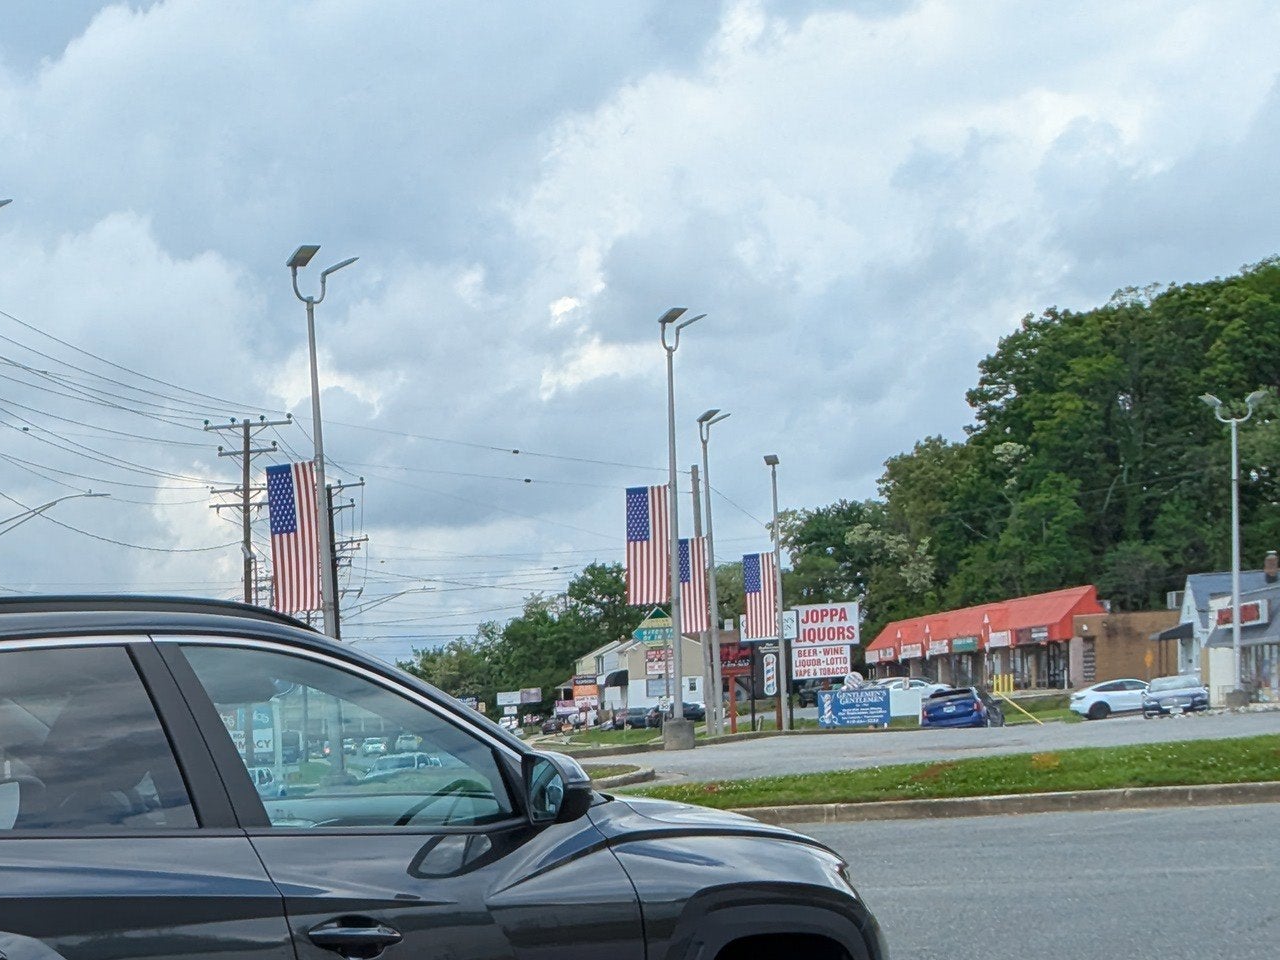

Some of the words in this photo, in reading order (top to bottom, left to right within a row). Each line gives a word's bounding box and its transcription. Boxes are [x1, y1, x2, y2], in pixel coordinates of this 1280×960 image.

[801, 607, 848, 624] JOPPA
[797, 648, 818, 658] BEER
[823, 647, 844, 656] WINE
[795, 659, 822, 668] LIQUOR
[826, 656, 848, 666] LOTTO
[795, 668, 811, 678] VAPE
[812, 668, 818, 676] &
[819, 666, 849, 675] TOBACCO
